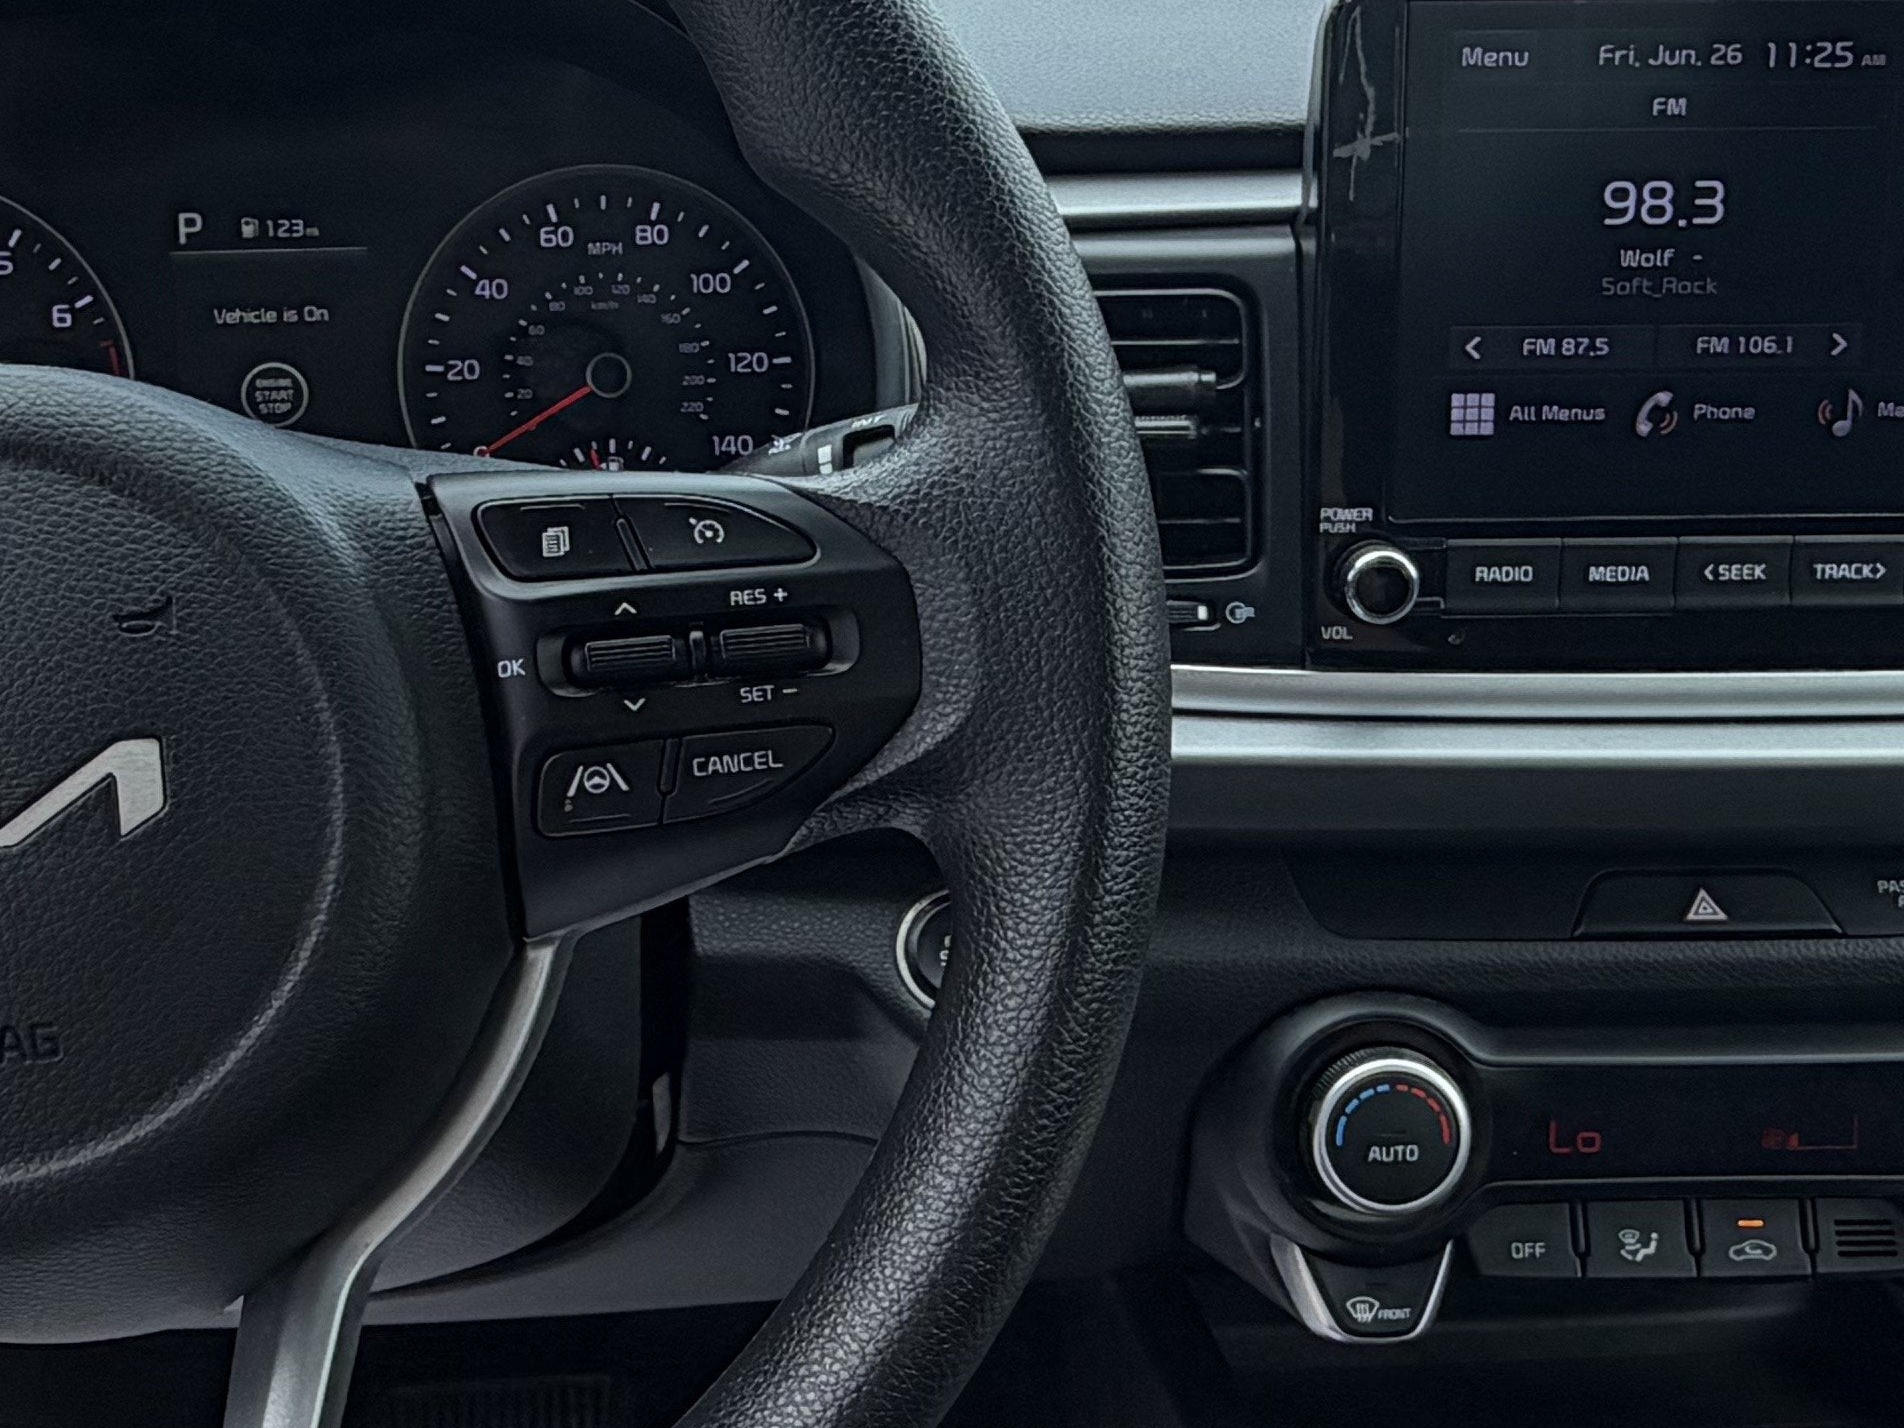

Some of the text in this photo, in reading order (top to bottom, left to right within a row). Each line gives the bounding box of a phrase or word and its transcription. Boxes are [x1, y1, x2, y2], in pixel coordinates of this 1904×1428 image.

[1461, 45, 1530, 68] Menu
[1598, 42, 1744, 68] Fri. Jun. 26
[1767, 40, 1887, 70] 11:25 AM
[1652, 97, 1687, 117] FM
[1602, 179, 1726, 228] 98.3
[177, 212, 203, 246] P
[539, 224, 575, 249] 60
[635, 224, 670, 246] 80
[587, 241, 624, 257] MPH
[1618, 248, 1676, 269] Wolf
[474, 278, 509, 300] 40
[690, 272, 732, 294] 100
[1601, 276, 1718, 299] Soft_Rock
[52, 304, 73, 329] 6
[213, 305, 330, 324] Vehicle is On
[1522, 337, 1610, 357] FM 87.5
[1696, 336, 1794, 355] FM 106.1
[446, 359, 480, 381] 20
[728, 352, 769, 373] 120
[255, 390, 294, 403] START
[259, 403, 293, 415] STOP
[1508, 404, 1606, 422] All Menus
[1693, 403, 1756, 421] Phone
[712, 434, 754, 456] 140
[1319, 506, 1374, 522] POWER
[1319, 522, 1356, 535] PUSH
[1474, 565, 1534, 583] RADIO
[1588, 565, 1651, 583] MEDIA
[730, 588, 768, 607] RES
[1320, 625, 1354, 641] VOL
[497, 658, 527, 679] OK
[740, 685, 776, 704] SET
[692, 749, 785, 778] CANCEL
[1549, 1119, 1603, 1154] Lo
[1367, 1144, 1420, 1163] AUTO
[1510, 1241, 1547, 1260] OFF
[1377, 1308, 1412, 1320] FRONT
